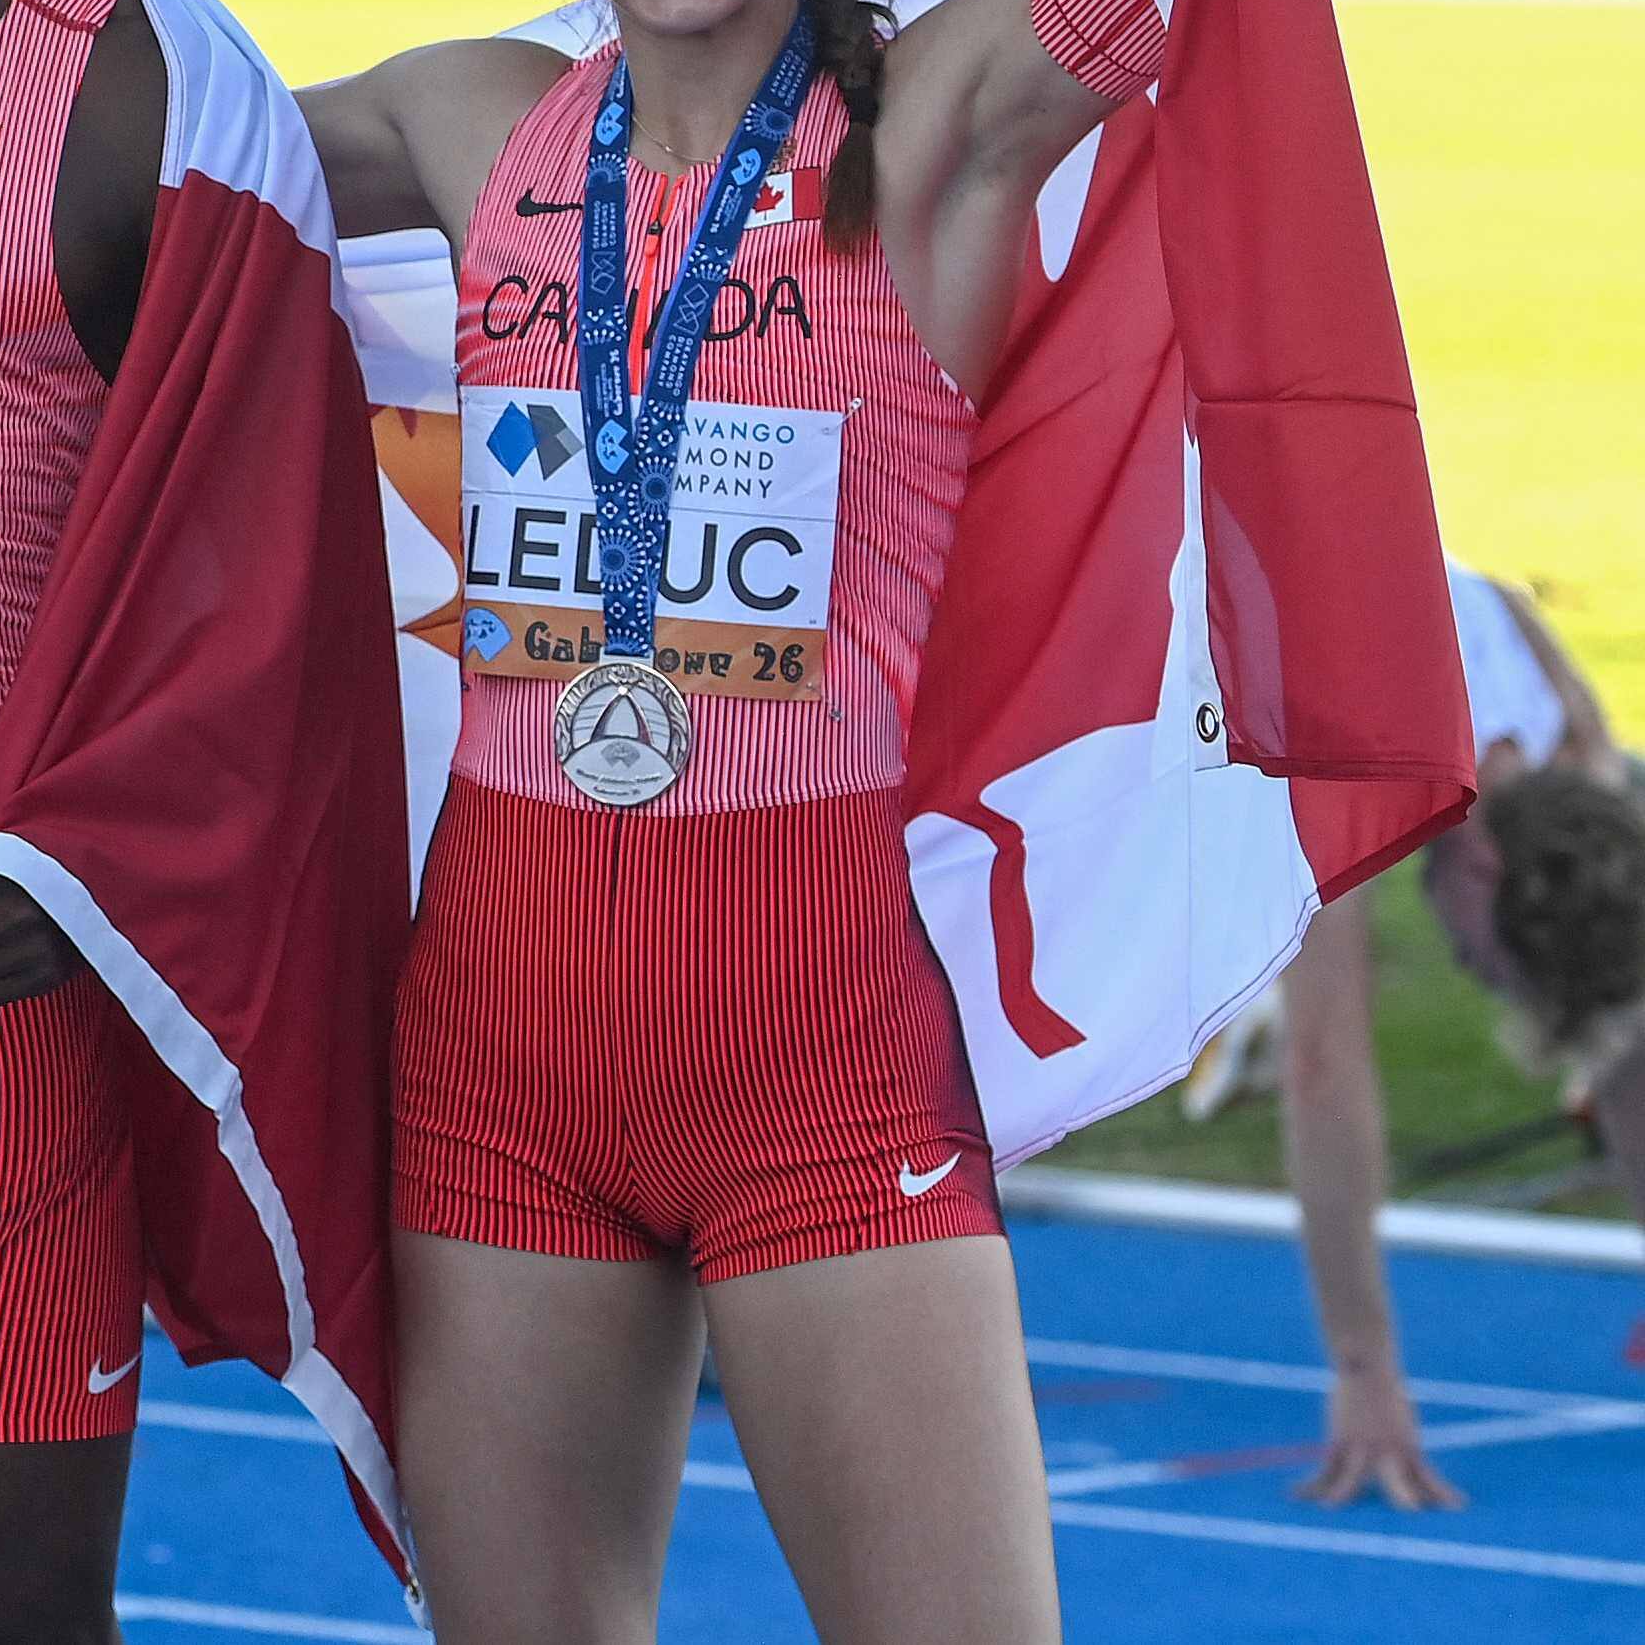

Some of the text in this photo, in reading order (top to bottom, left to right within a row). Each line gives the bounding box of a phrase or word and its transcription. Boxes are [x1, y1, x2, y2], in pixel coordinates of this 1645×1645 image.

[483, 276, 810, 348] CADA
[682, 418, 795, 444] VANGO
[685, 448, 774, 470] MOND
[675, 475, 772, 499] MPANY
[525, 621, 805, 683] Gabone 26
